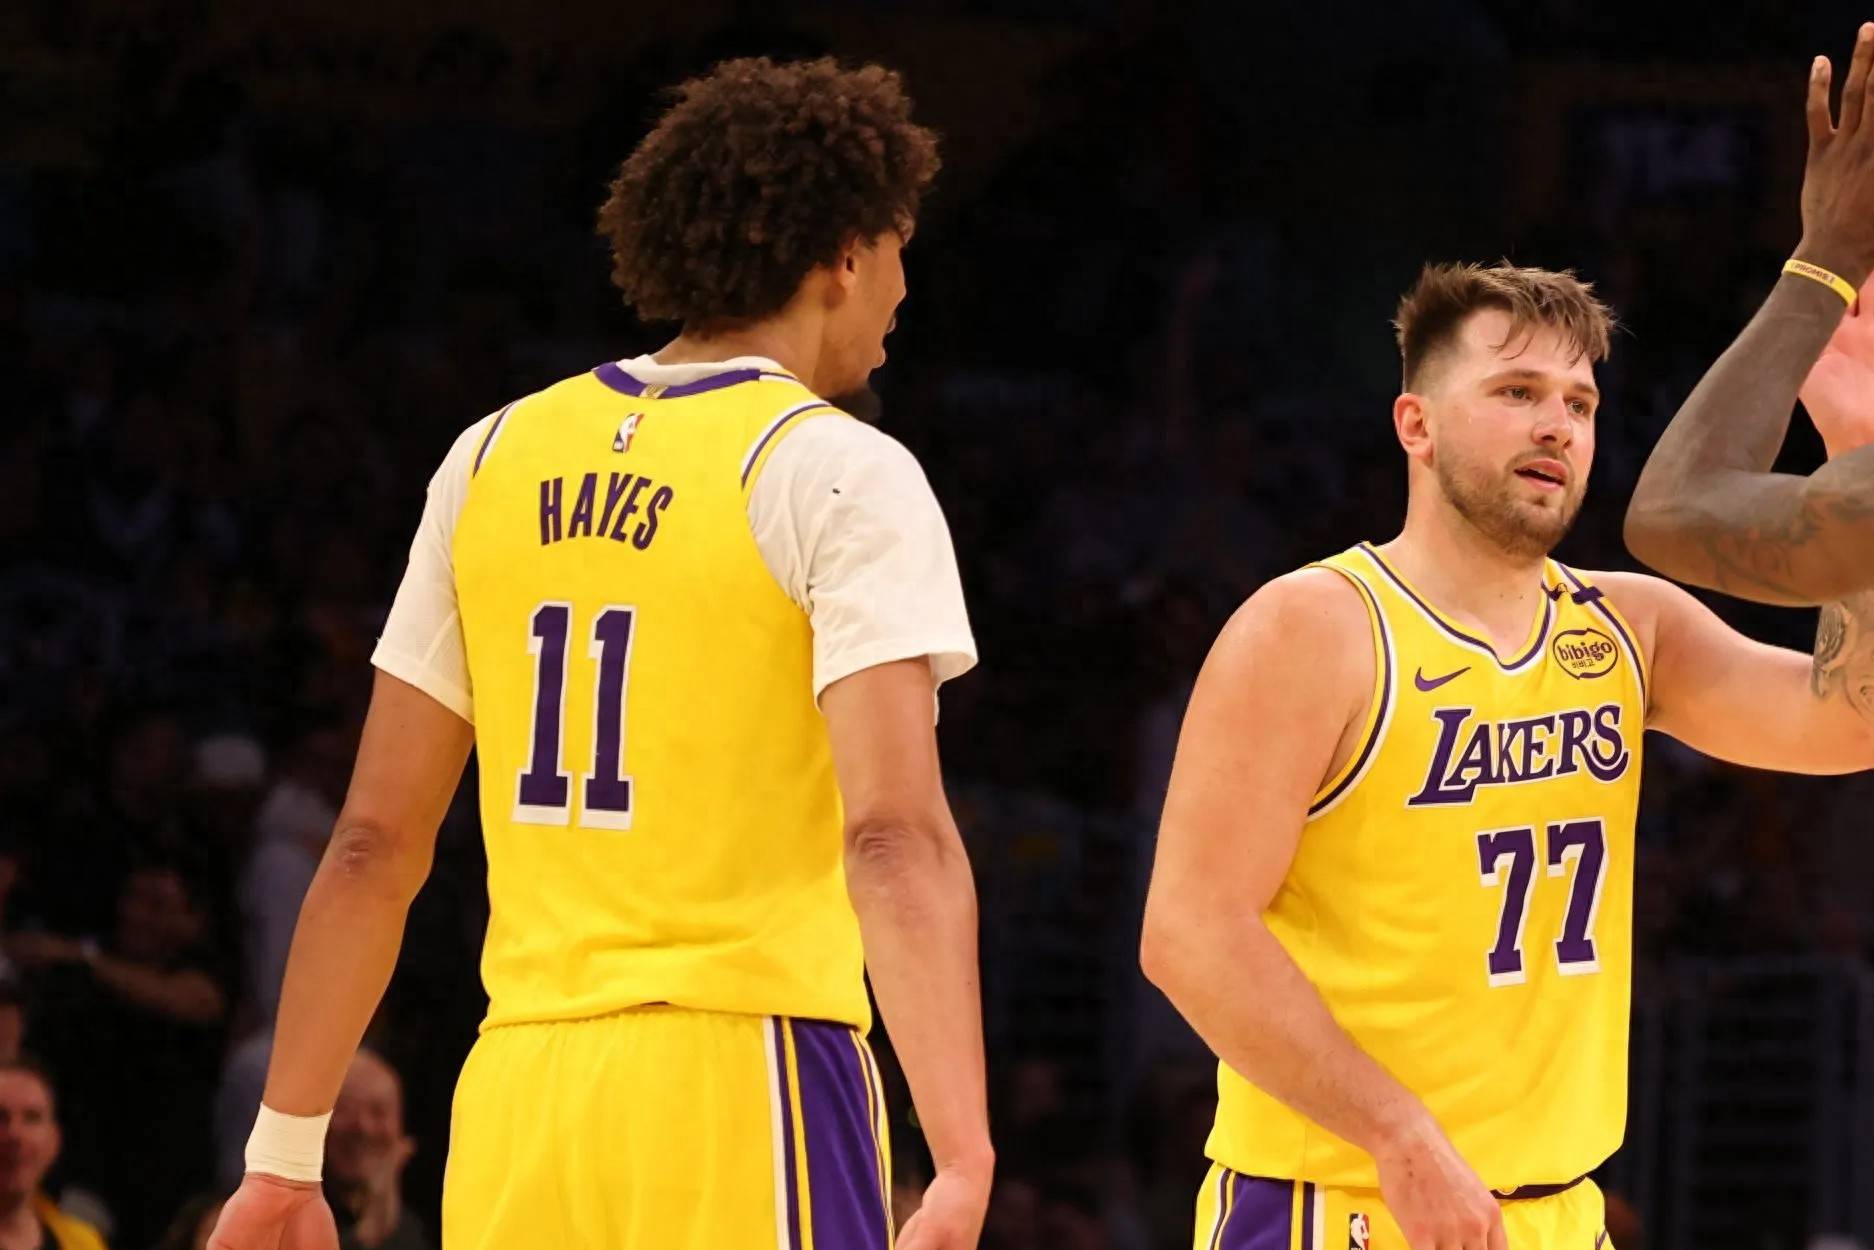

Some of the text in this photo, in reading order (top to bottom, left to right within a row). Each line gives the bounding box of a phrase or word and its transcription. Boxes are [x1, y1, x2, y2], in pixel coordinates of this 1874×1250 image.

[540, 472, 673, 551] HAYES
[1557, 641, 1613, 661] bibigo
[511, 600, 637, 831] 11
[1404, 703, 1632, 811] LAKERS
[1476, 816, 1609, 989] 77
